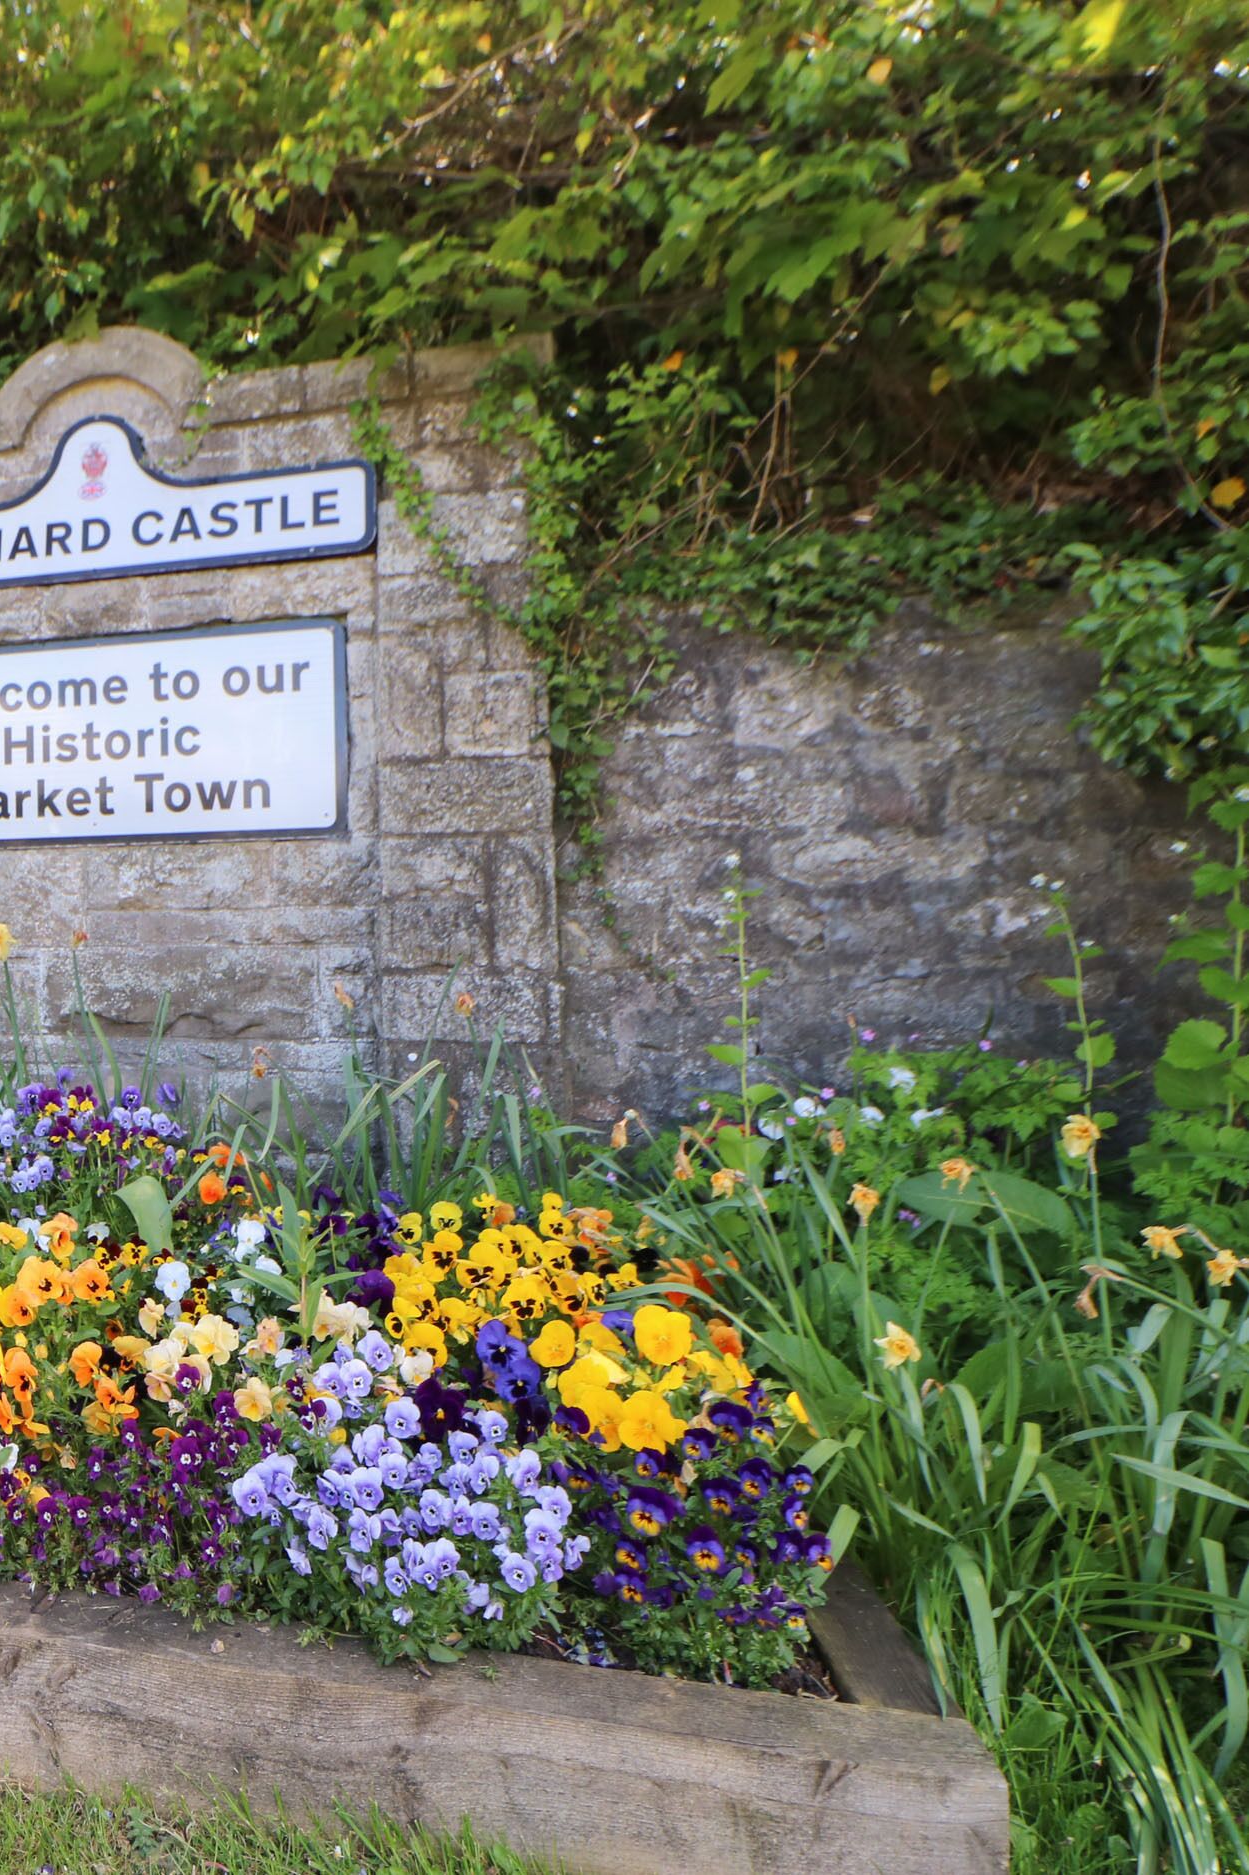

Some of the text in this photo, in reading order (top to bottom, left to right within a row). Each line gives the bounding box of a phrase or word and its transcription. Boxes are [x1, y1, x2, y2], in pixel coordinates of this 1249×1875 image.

[131, 488, 341, 547] CASTLE
[148, 661, 201, 701] to
[221, 659, 311, 697] our
[3, 716, 202, 766] Historic
[133, 773, 272, 813] Town
